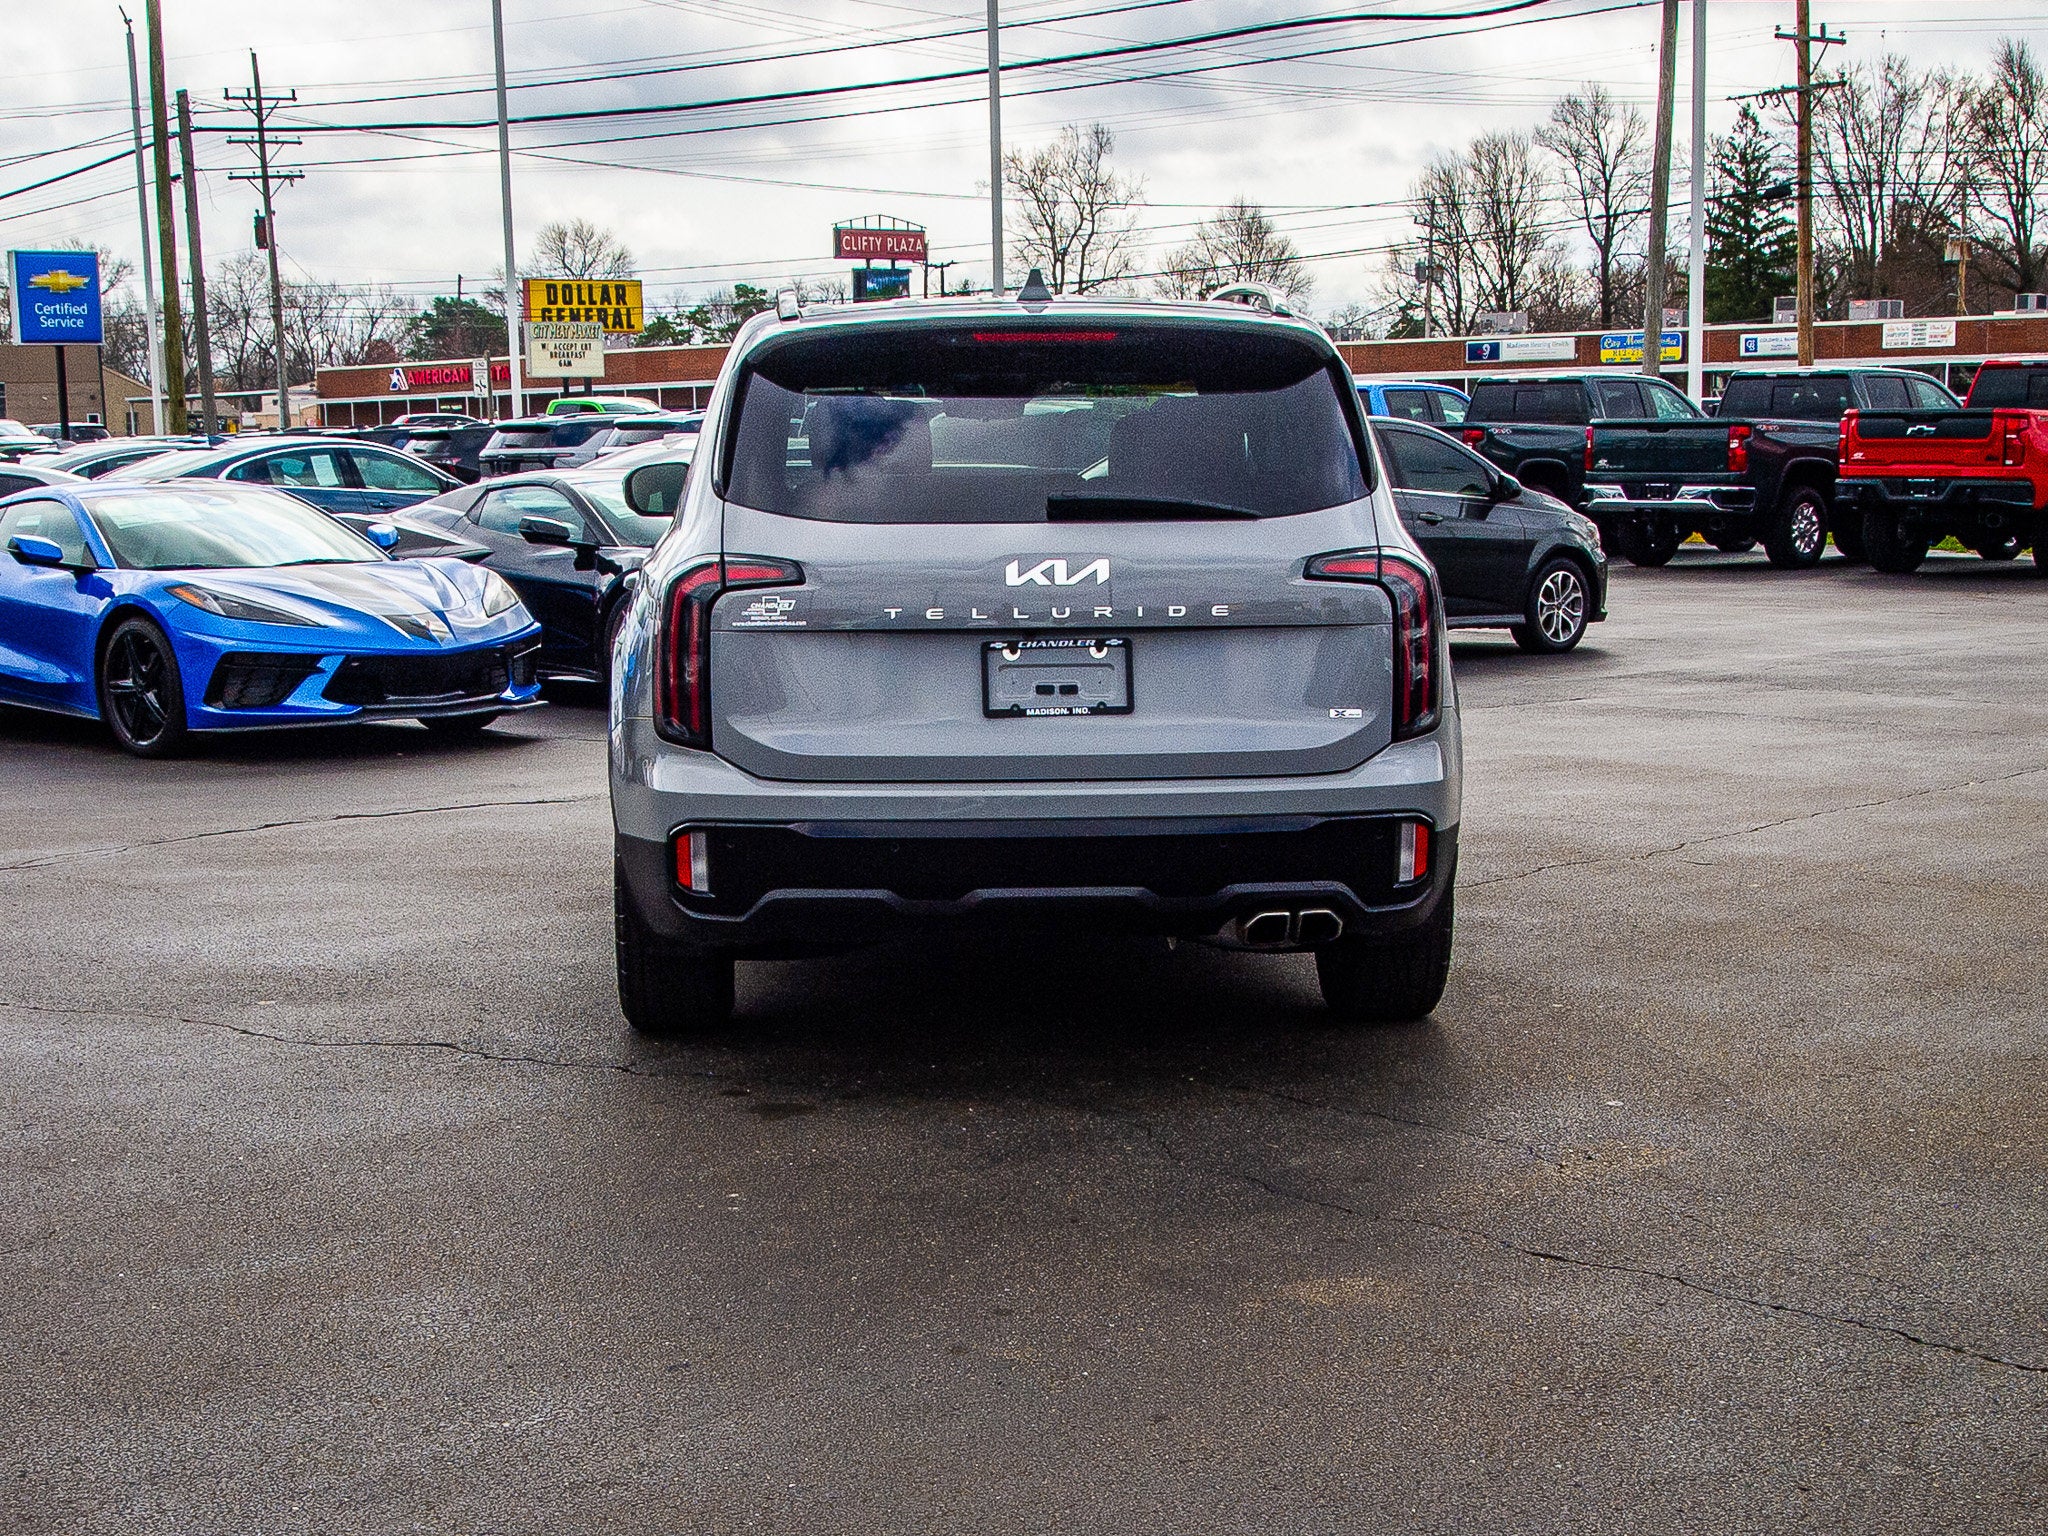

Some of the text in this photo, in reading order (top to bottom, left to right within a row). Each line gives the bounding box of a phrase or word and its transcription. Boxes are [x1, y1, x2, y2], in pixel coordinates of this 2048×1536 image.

[842, 235, 923, 253] CLIFTY PLAZA
[545, 283, 628, 306] DOLLAR
[34, 302, 88, 316] Certified
[39, 315, 85, 329] Service
[541, 307, 635, 330] GENERAL
[553, 342, 577, 351] ACCEPT
[550, 351, 586, 360] BREAKFAST
[407, 366, 470, 386] AMERICAN
[884, 604, 1231, 620] TELLURIDE
[1017, 639, 1097, 649] CHANDLER
